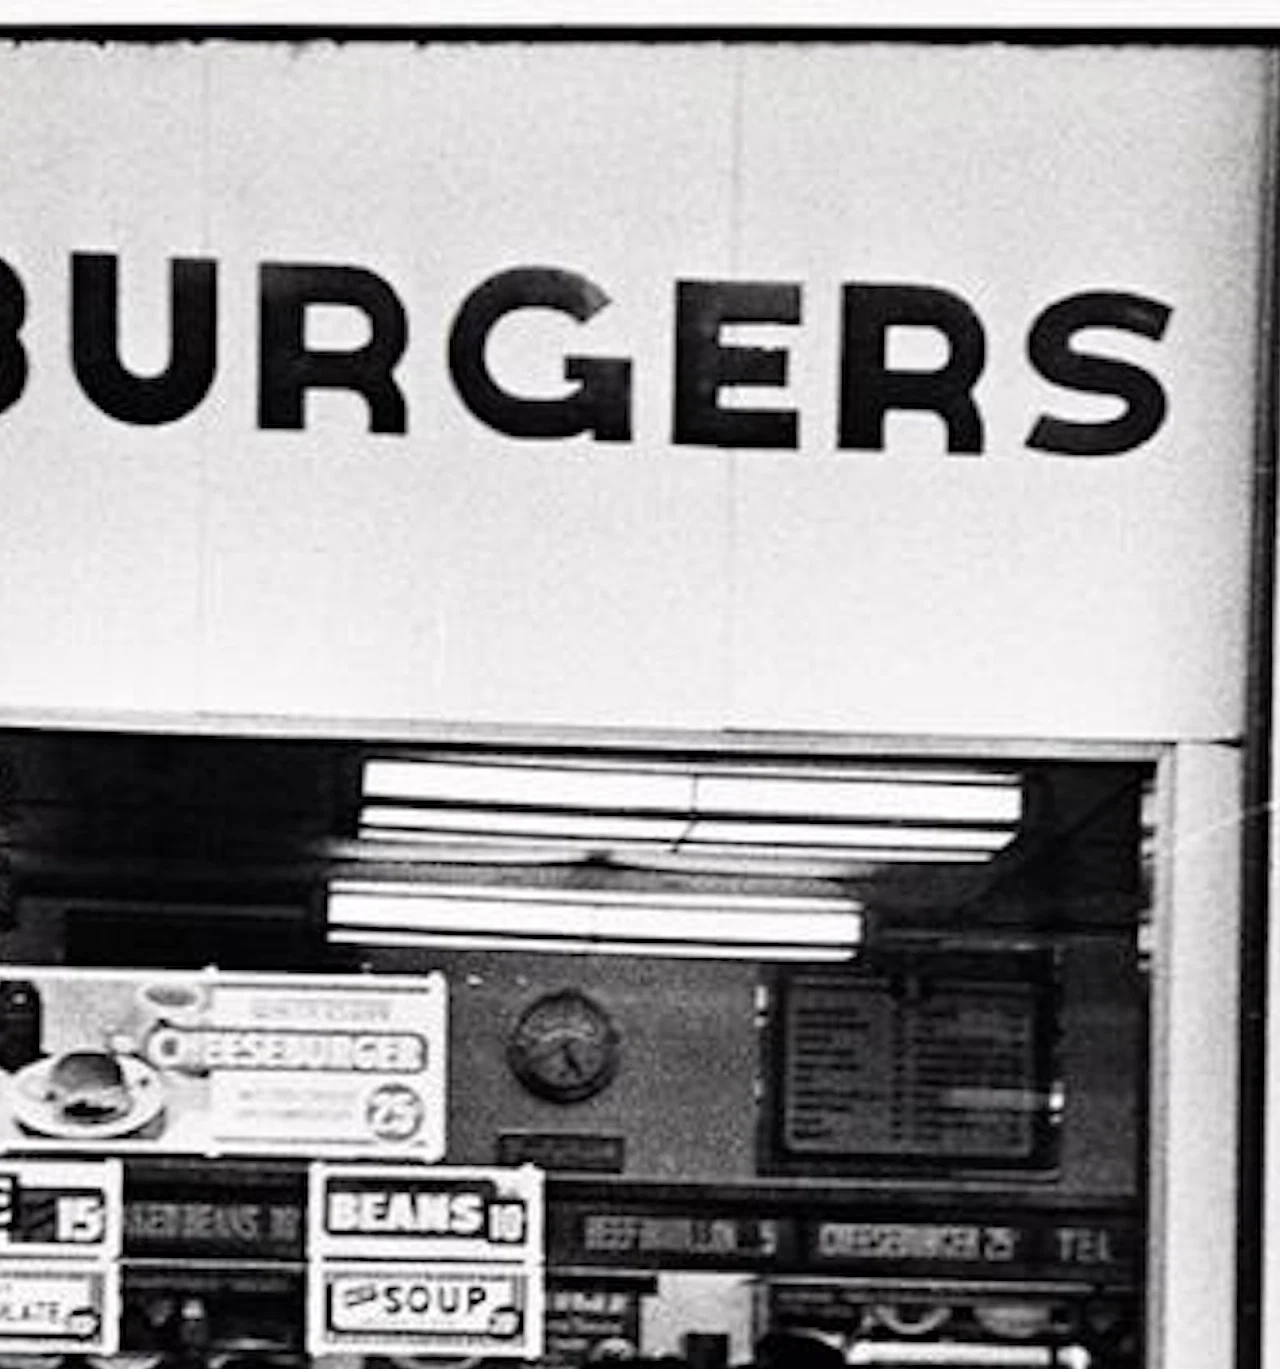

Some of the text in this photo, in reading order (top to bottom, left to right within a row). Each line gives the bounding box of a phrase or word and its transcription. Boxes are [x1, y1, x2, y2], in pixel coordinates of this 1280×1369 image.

[148, 1029, 423, 1070] CHEESEBURGER
[372, 1092, 418, 1136] 25
[58, 1196, 105, 1241] 15
[327, 1191, 523, 1242] BEANS 10
[384, 1285, 486, 1314] SOUP
